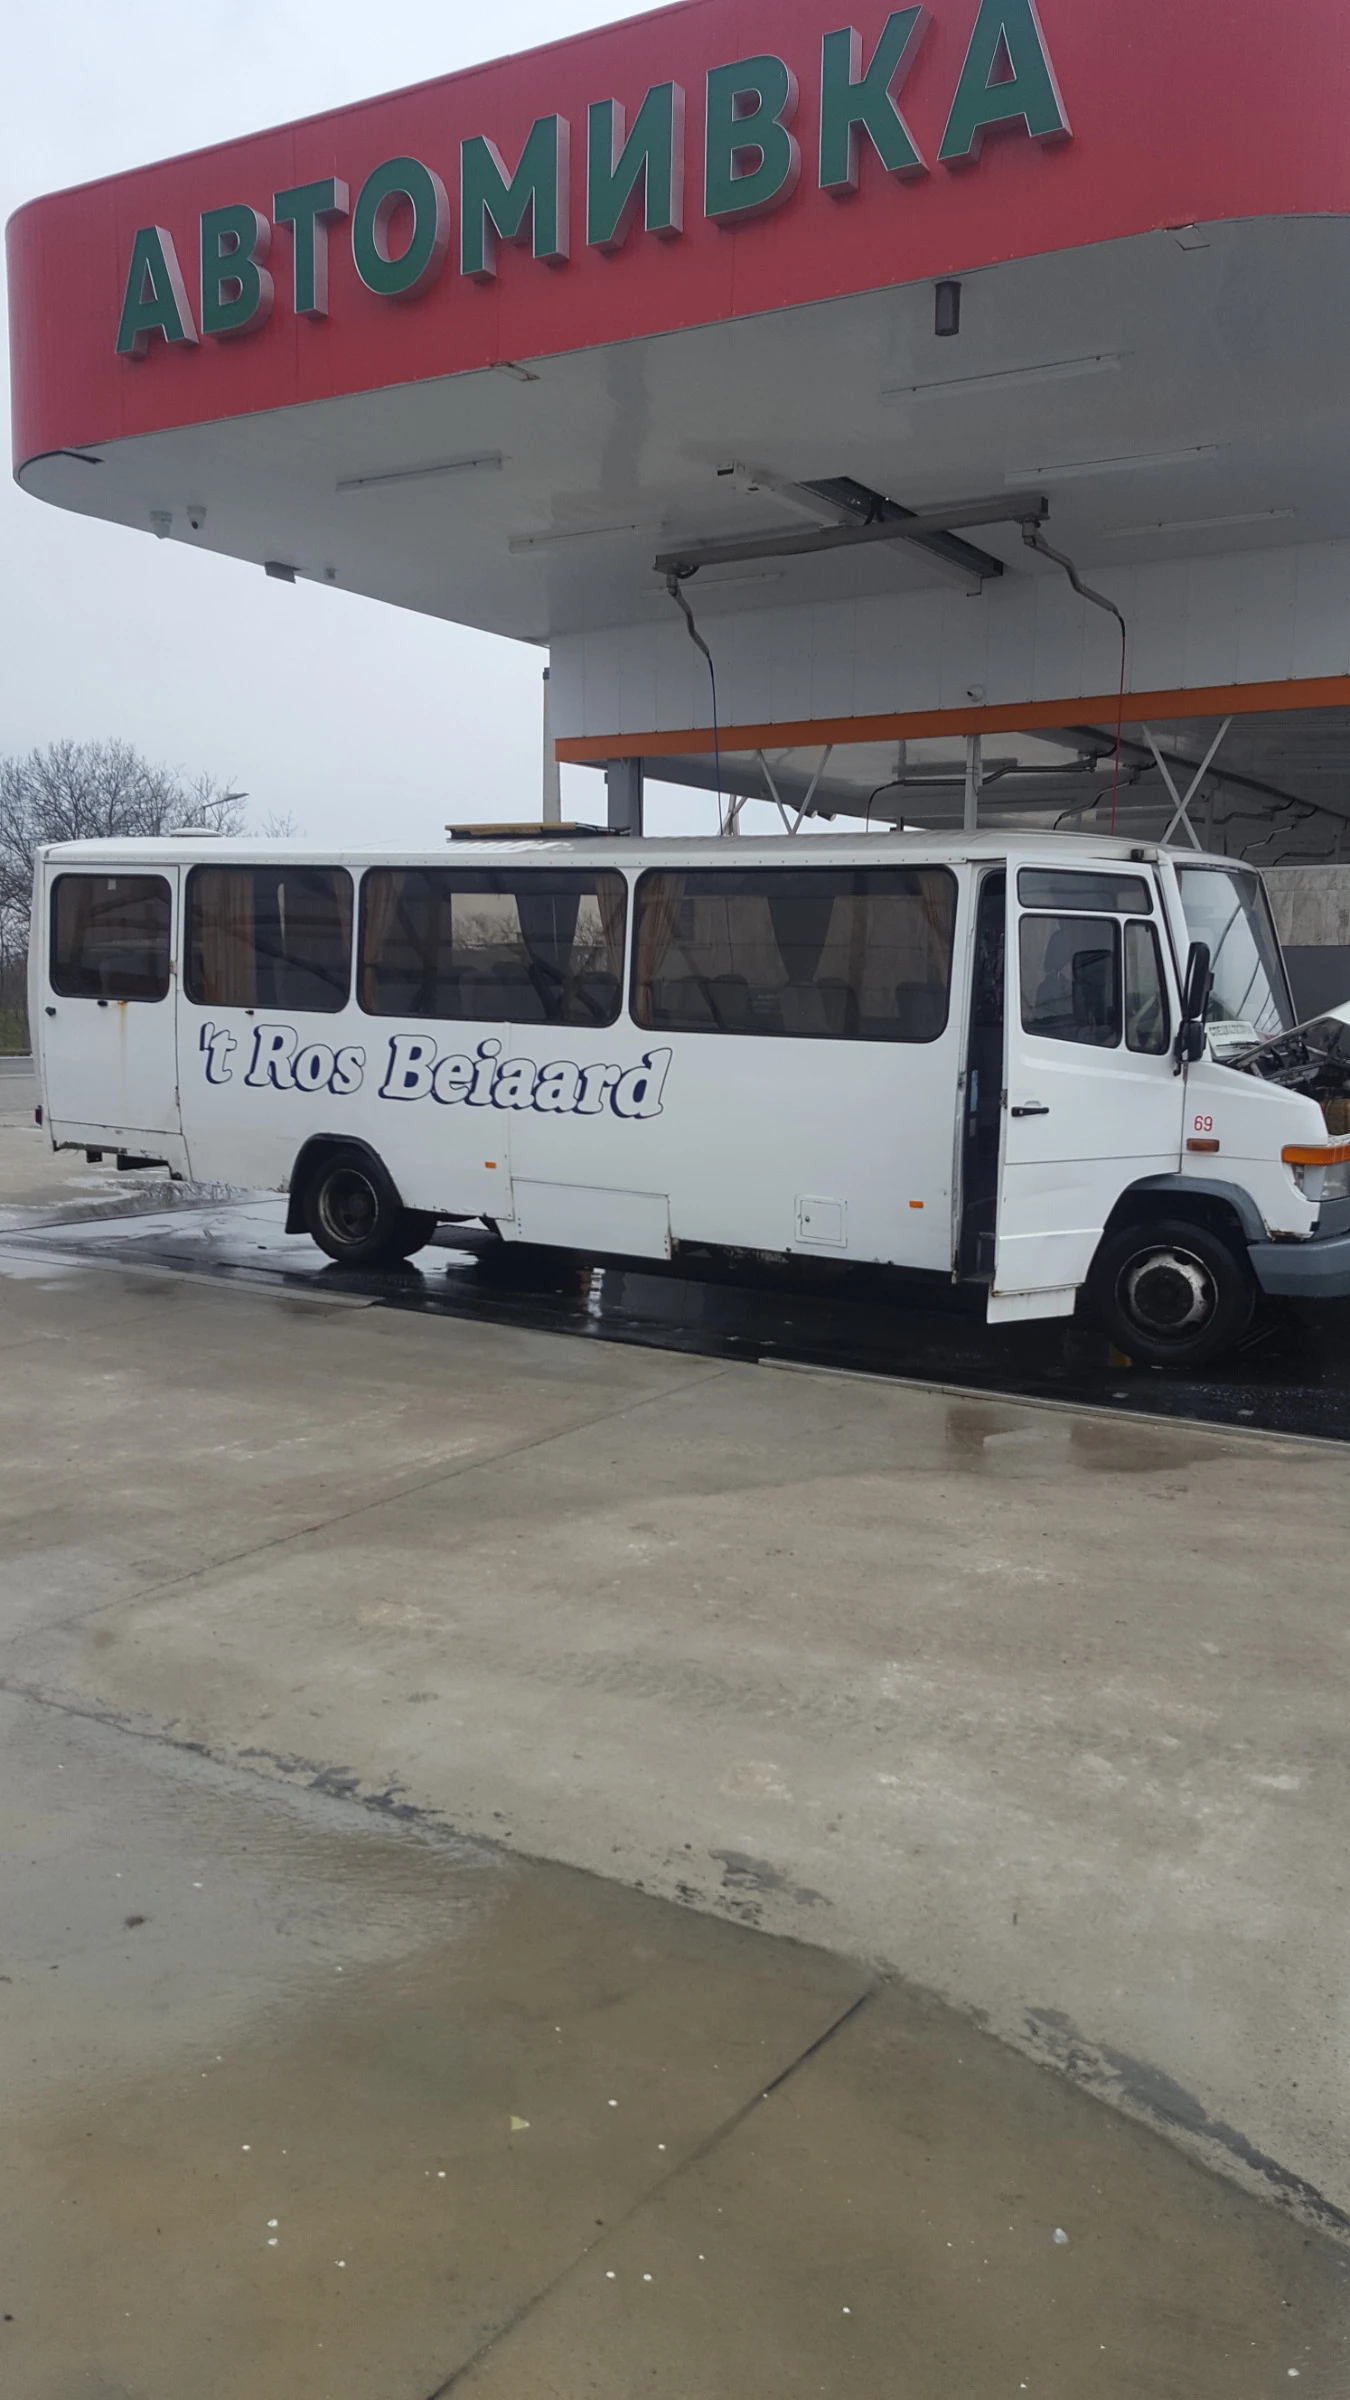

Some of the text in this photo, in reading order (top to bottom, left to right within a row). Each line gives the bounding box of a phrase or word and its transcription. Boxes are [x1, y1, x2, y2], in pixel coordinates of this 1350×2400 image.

[115, 0, 1073, 360] АВТОМИВКА
[199, 1021, 673, 1119] 't Ros Beiaard
[1194, 1115, 1213, 1132] 69
